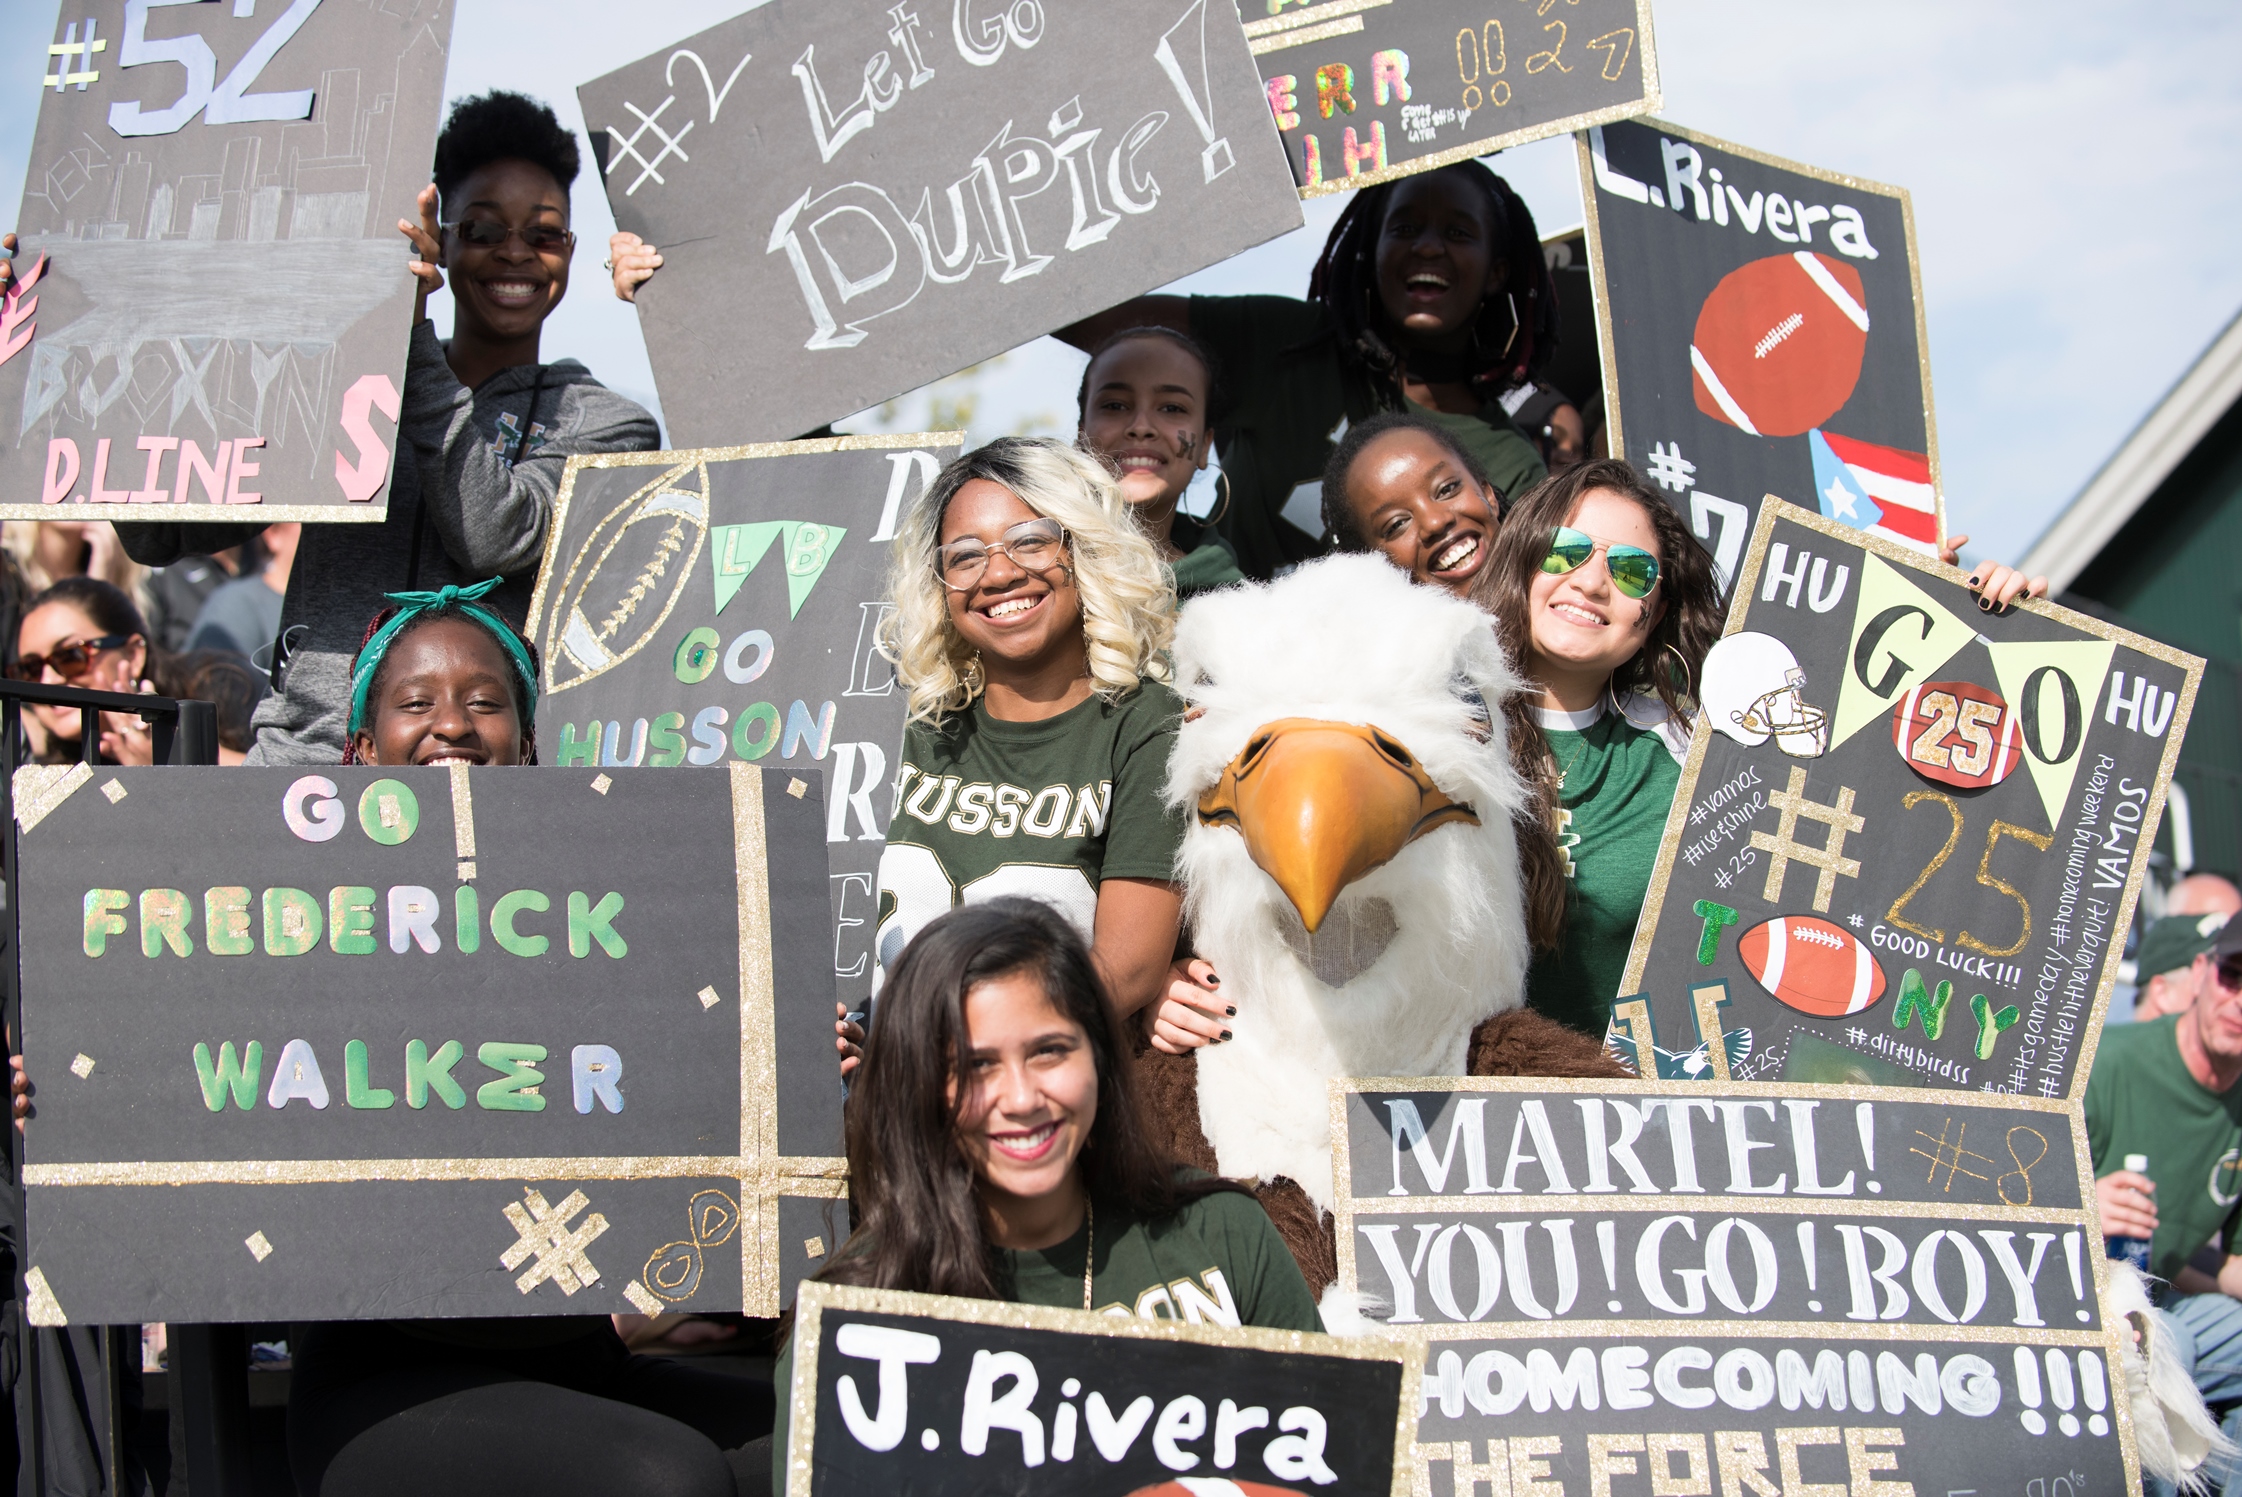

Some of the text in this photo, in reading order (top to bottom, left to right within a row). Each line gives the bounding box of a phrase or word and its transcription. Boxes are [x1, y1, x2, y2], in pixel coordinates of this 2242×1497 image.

[792, 0, 1045, 163] Let Go
[1762, 542, 1849, 613] HU
[673, 627, 774, 684] GO
[557, 700, 837, 767] HUSSON
[1911, 690, 2002, 777] 25
[2104, 671, 2175, 738] HU
[1690, 765, 1762, 826] #vamos
[2093, 777, 2148, 889] VAMOS
[82, 885, 628, 960] FREDERICK
[1871, 925, 1930, 959] GOOD
[1936, 947, 2022, 990] LUCK!!!
[193, 1038, 625, 1115] WALKER
[1383, 1098, 1882, 1196] MARTEL!
[1418, 1427, 1914, 1497] THE FORCE
